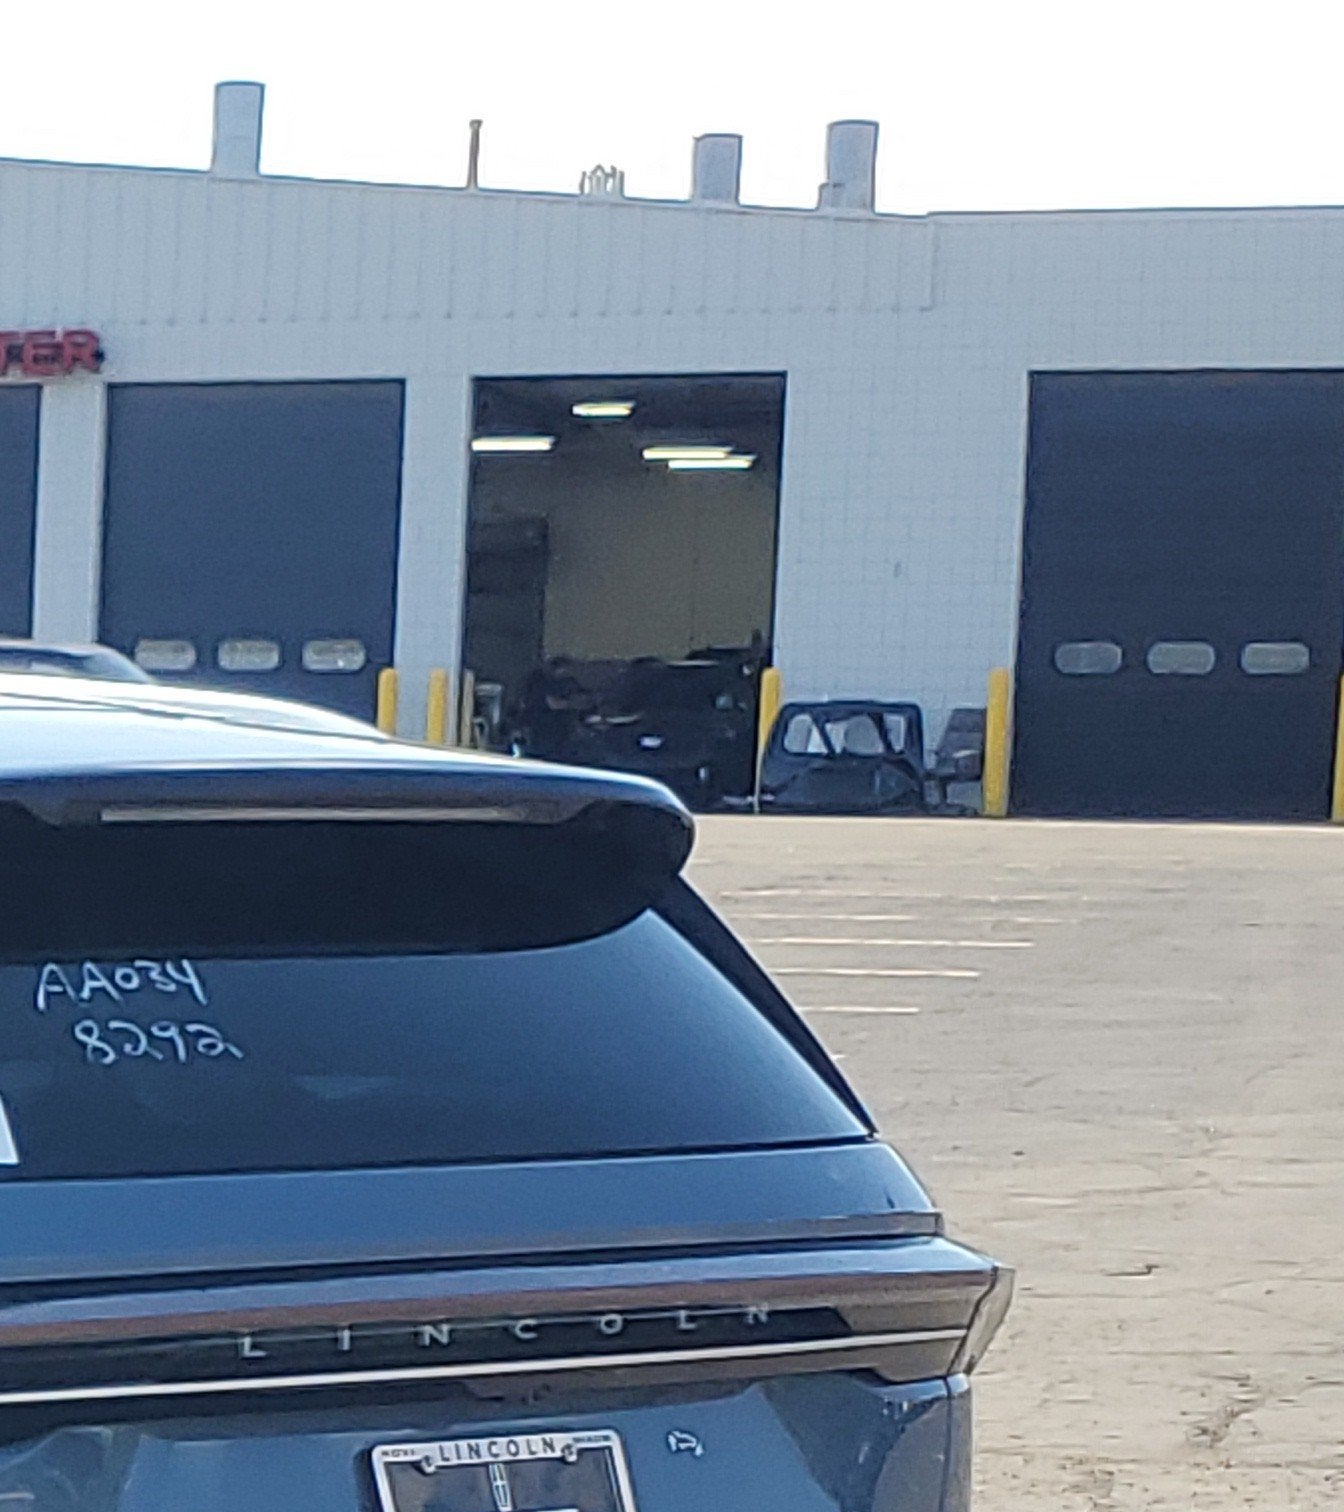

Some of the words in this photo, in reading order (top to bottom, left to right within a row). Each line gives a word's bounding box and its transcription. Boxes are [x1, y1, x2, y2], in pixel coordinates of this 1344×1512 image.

[74, 1018, 244, 1064] 8292
[238, 1304, 771, 1360] LINCOLN
[438, 1436, 556, 1463] LINCOLN
